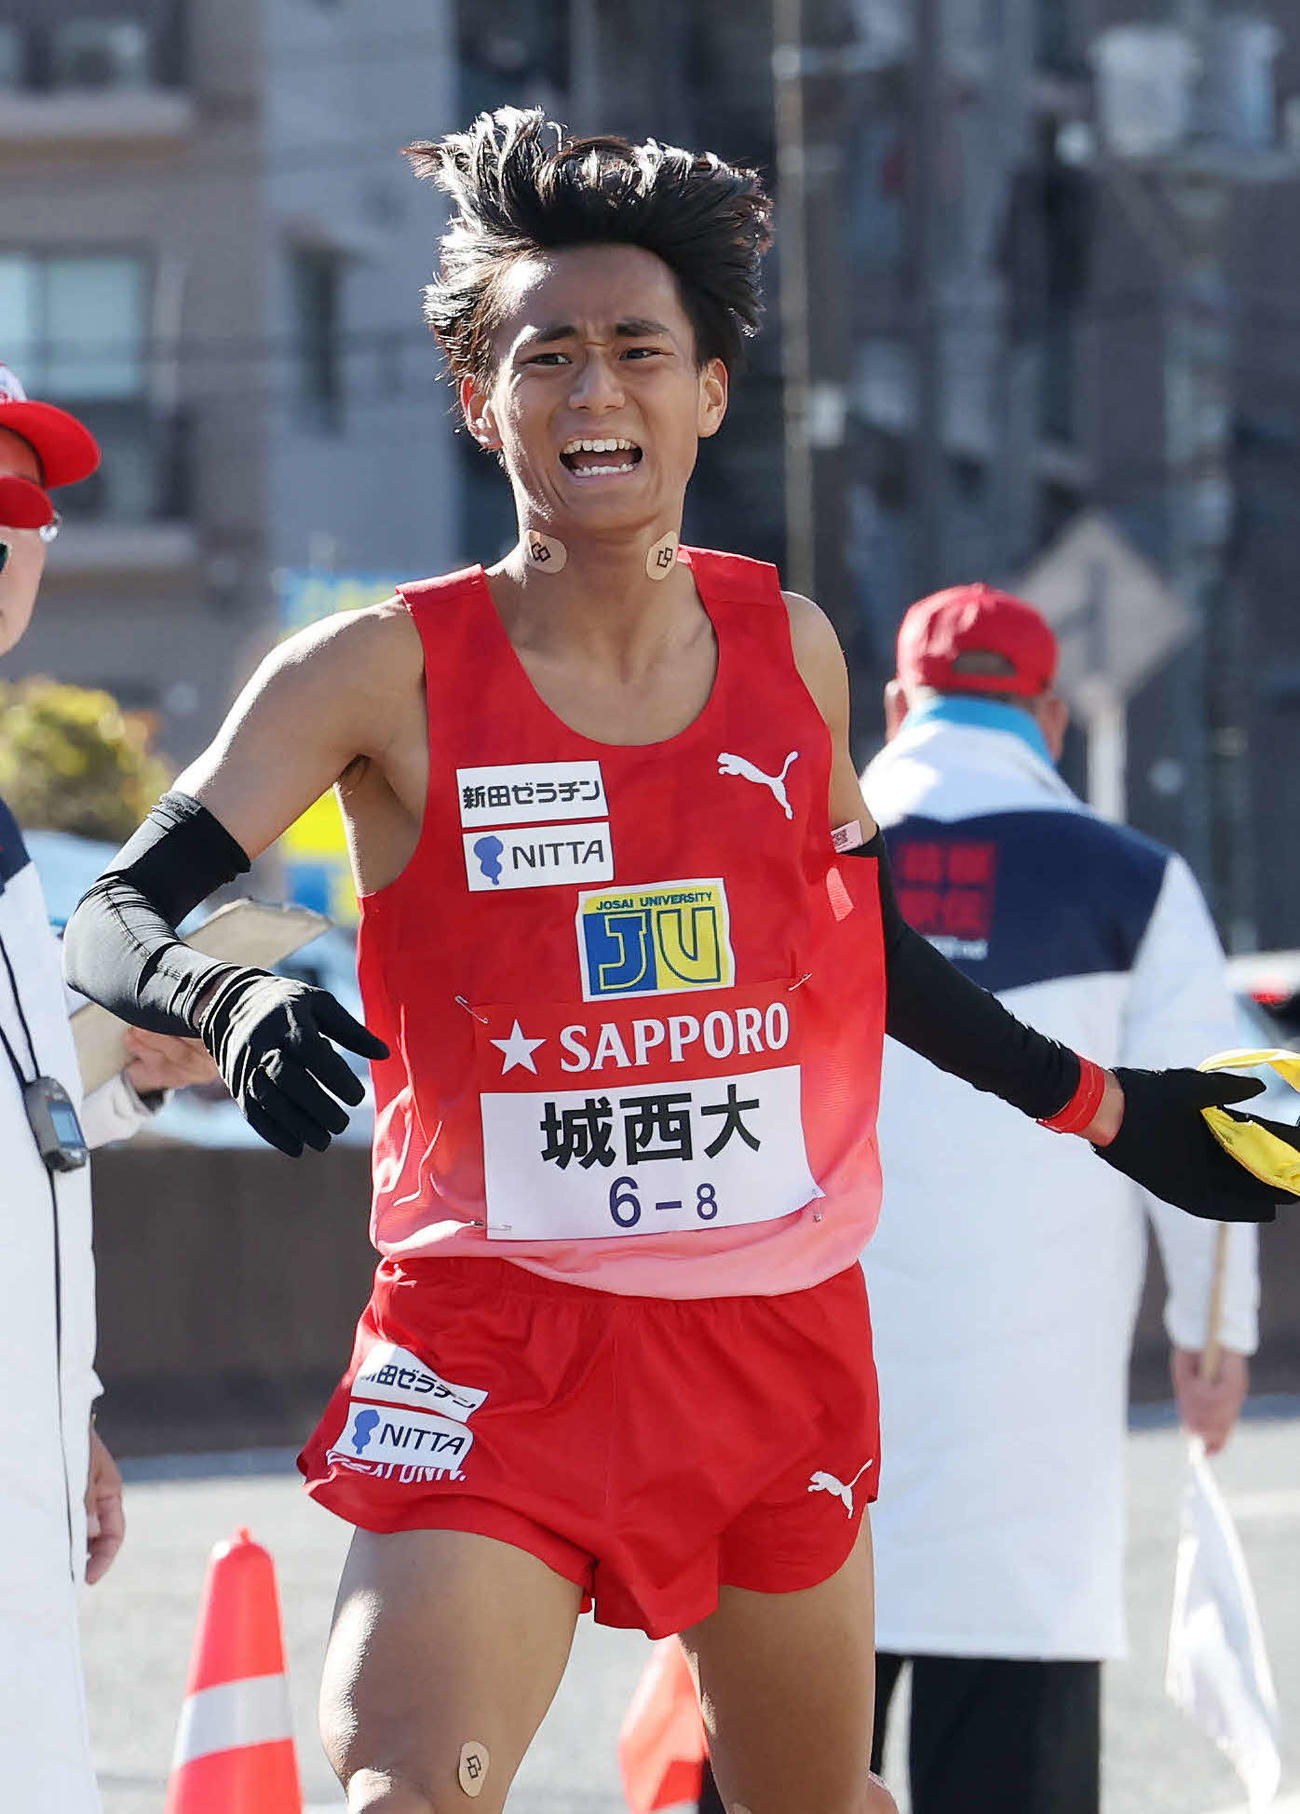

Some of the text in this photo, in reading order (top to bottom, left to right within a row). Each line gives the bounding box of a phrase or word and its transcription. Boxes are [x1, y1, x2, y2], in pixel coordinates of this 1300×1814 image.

[462, 779, 601, 810] 新田ゼラチン
[511, 839, 605, 870] NITTA
[596, 891, 713, 911] JOSAI UNIVERSITY
[598, 906, 721, 991] JU
[559, 1002, 790, 1073] SAPPORO
[539, 1083, 761, 1170] 城西大
[360, 1364, 477, 1409] 田ゼラチン
[379, 1423, 466, 1456] NITTA
